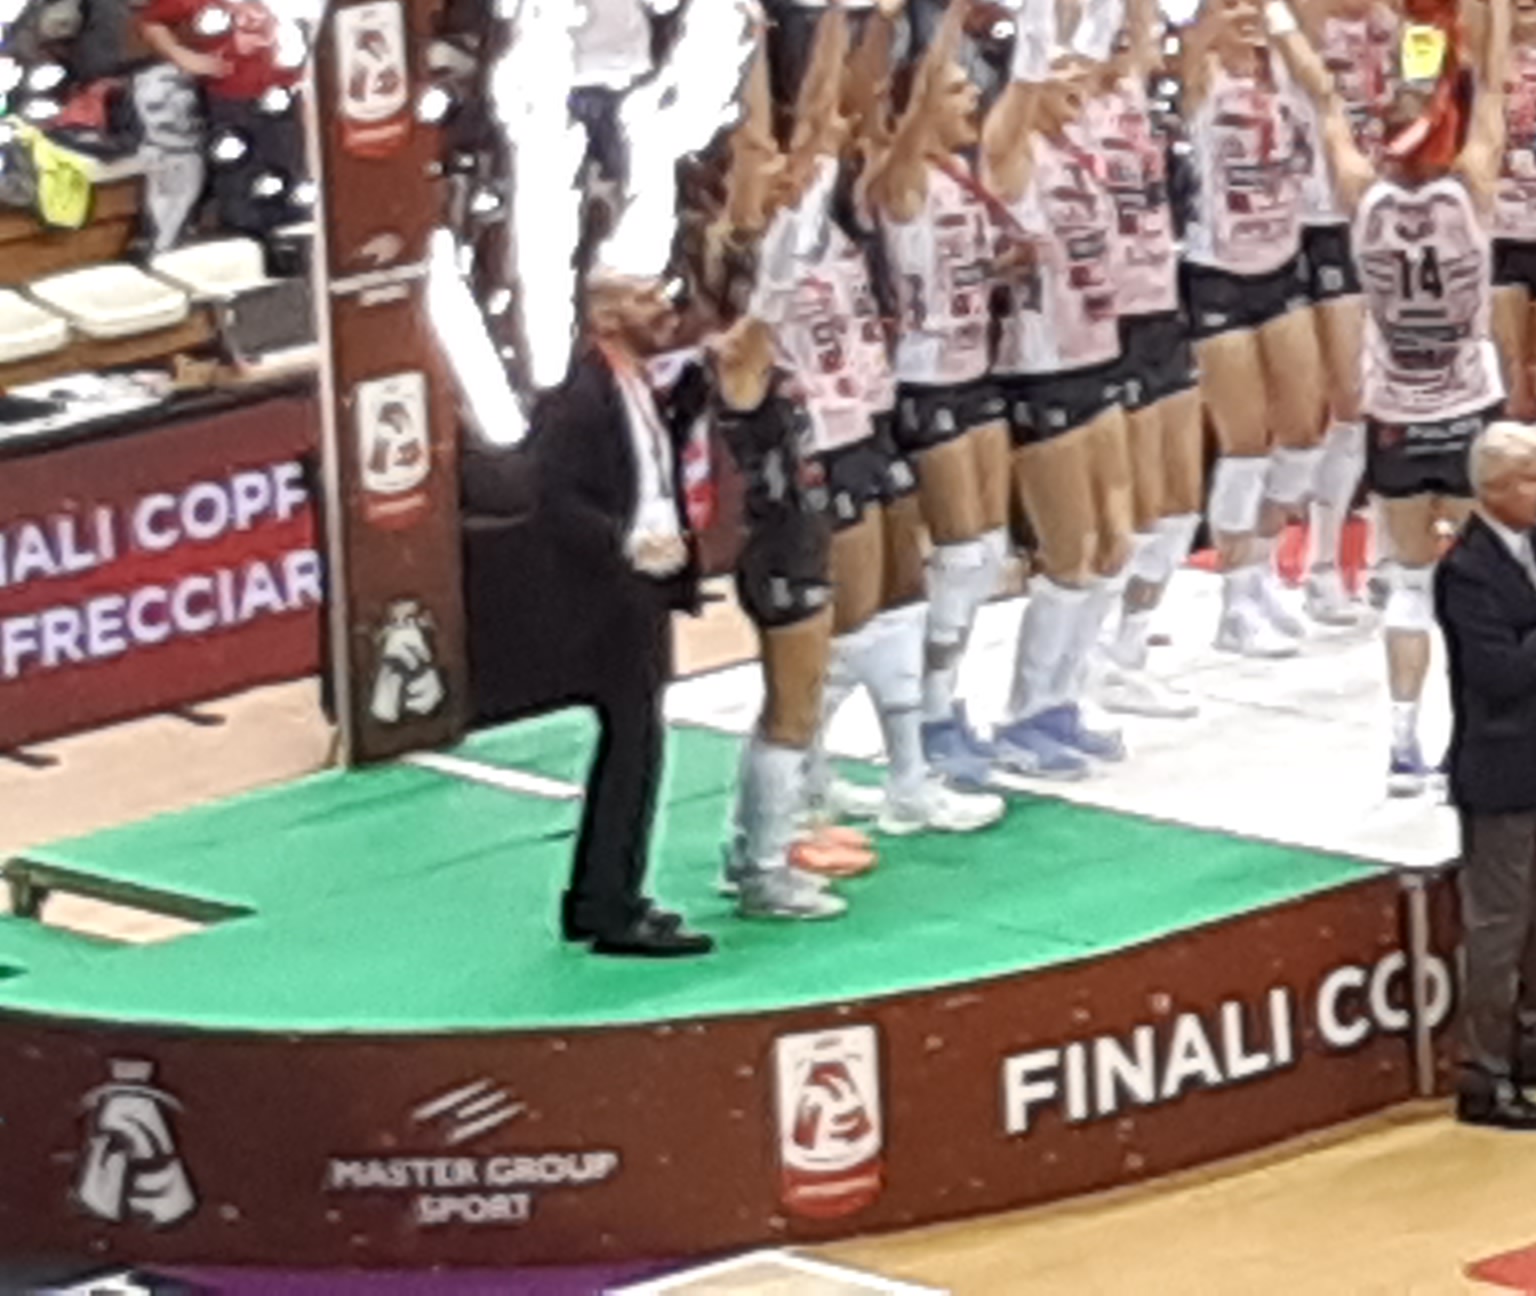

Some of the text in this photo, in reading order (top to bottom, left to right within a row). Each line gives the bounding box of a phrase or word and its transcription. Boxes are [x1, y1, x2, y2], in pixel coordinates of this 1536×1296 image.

[1392, 246, 1443, 301] 14
[0, 506, 116, 586] ALI
[2, 549, 323, 678] FRECCIAR
[1004, 987, 1294, 1135] FINALI
[331, 1149, 620, 1189] MASTER GROUP
[417, 1192, 533, 1225] SPORT
